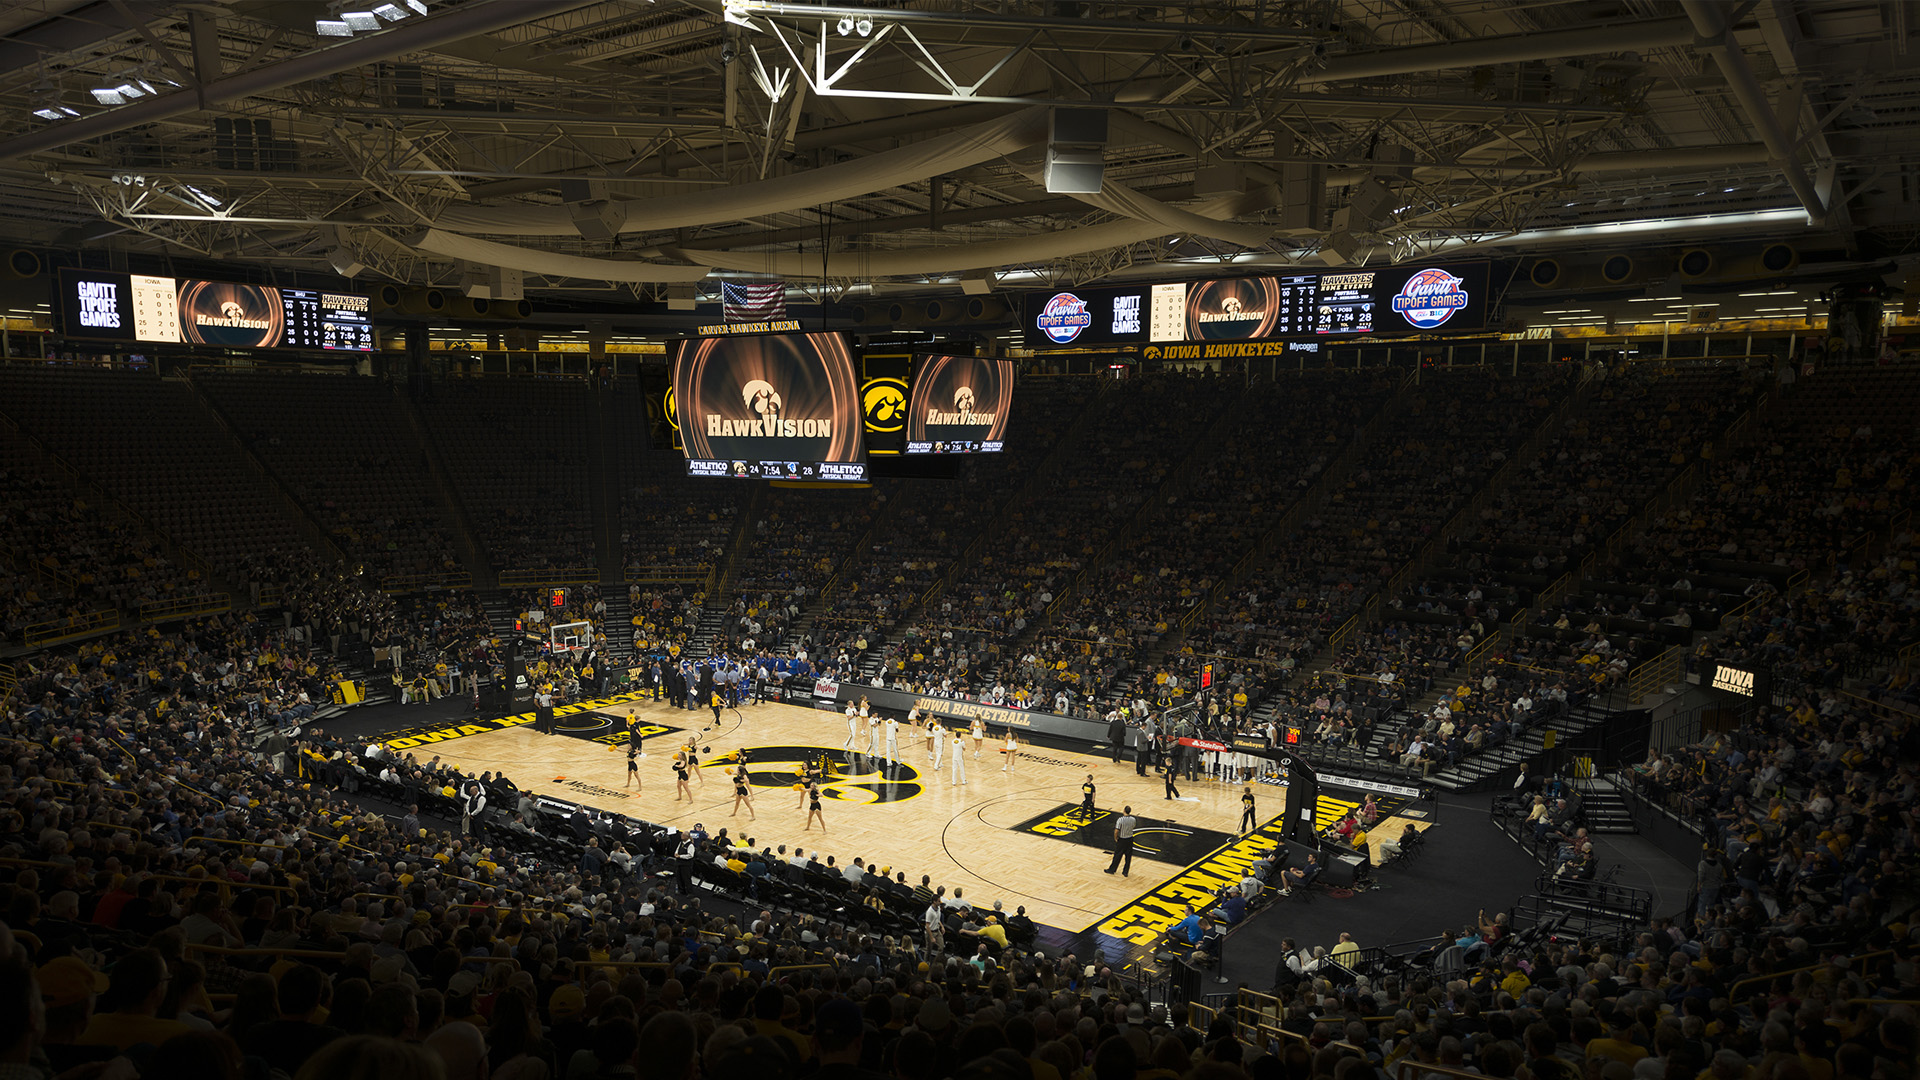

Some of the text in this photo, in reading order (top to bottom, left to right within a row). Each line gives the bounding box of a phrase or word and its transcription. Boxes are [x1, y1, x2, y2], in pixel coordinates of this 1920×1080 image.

[1321, 273, 1375, 285] HAWKEYES
[78, 281, 116, 298] GAVITT
[1406, 276, 1464, 298] Gavitt
[78, 296, 117, 312] TIPOFF
[322, 294, 368, 306] HAWKEYES
[1114, 296, 1141, 309] GAVITT
[1396, 294, 1464, 308] TIPOFF GAMES
[1046, 300, 1087, 317] Gavitt
[1113, 308, 1139, 321] TIPOFF
[80, 311, 121, 328] GAMES
[1040, 315, 1088, 326] TIPOFF GAMES
[1319, 313, 1372, 324] 24 7:54 28
[698, 320, 800, 335] CARVER-HAWKEYE ARENA
[1112, 320, 1140, 334] GAMES
[1163, 342, 1284, 359] IOWA HAWKEYES
[1290, 342, 1318, 351] Mycogen
[690, 460, 727, 471] ATHLETICO
[764, 466, 780, 475] 7:54
[819, 464, 863, 475] ATHLETICO
[552, 595, 563, 606] 30
[1714, 665, 1754, 688] IOWA
[919, 698, 1030, 726] IOWA BASKETBALL
[1287, 733, 1297, 743] 30
[1014, 752, 1088, 768] Mediacom
[565, 780, 630, 799] Mediacom
